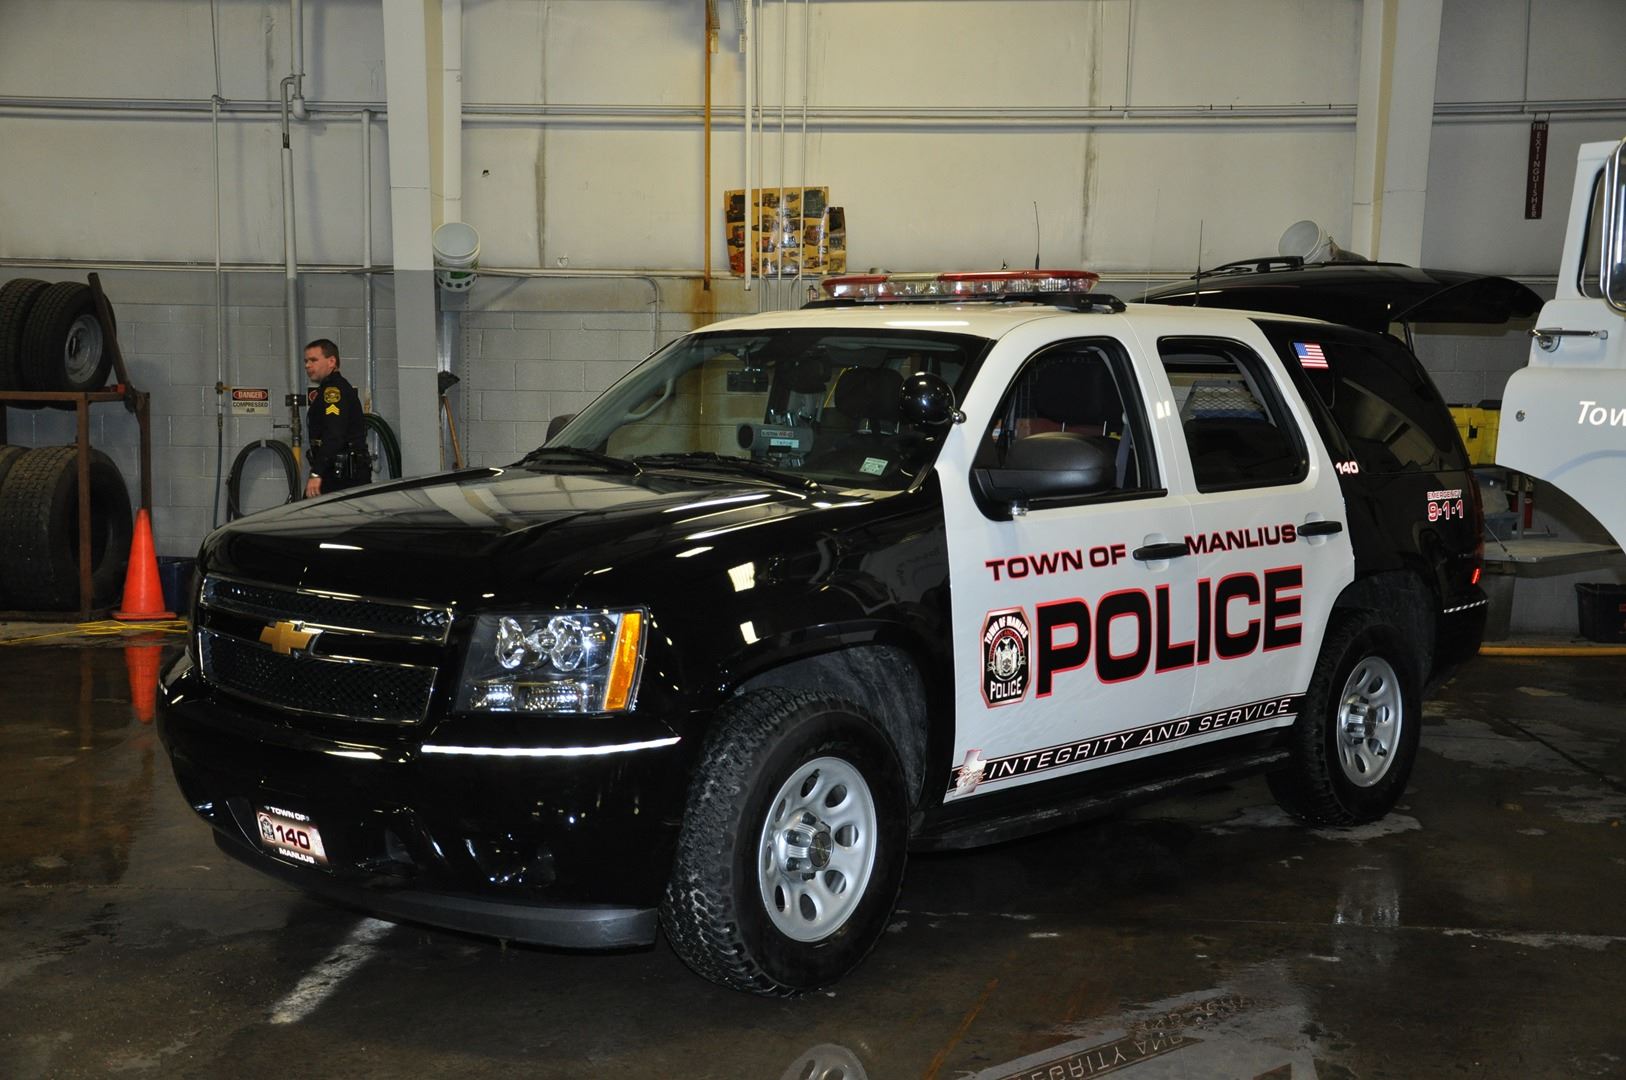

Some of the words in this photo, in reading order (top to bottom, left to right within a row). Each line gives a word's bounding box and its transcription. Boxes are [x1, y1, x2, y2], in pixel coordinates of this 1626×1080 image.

[1530, 132, 1542, 218] EXTINGUISHER
[238, 391, 263, 399] DANGER
[1335, 460, 1360, 475] 140
[1426, 489, 1462, 501] EMERGENCY
[985, 549, 1083, 581] TOWN
[1089, 544, 1126, 568] OF
[1184, 524, 1296, 556] MANLIUS
[984, 620, 1000, 644] TOWN
[998, 616, 1006, 628] OF
[1006, 616, 1028, 640] MANLIUS
[1035, 564, 1303, 699] POLICE
[990, 676, 1023, 700] POLICE
[988, 732, 1134, 780] INTEGRITY
[1140, 720, 1190, 745] AND
[1198, 698, 1292, 732] SERVICE
[270, 806, 295, 819] TOWN
[294, 812, 306, 822] OF
[276, 824, 310, 850] 140
[278, 848, 314, 864] MANLIUS
